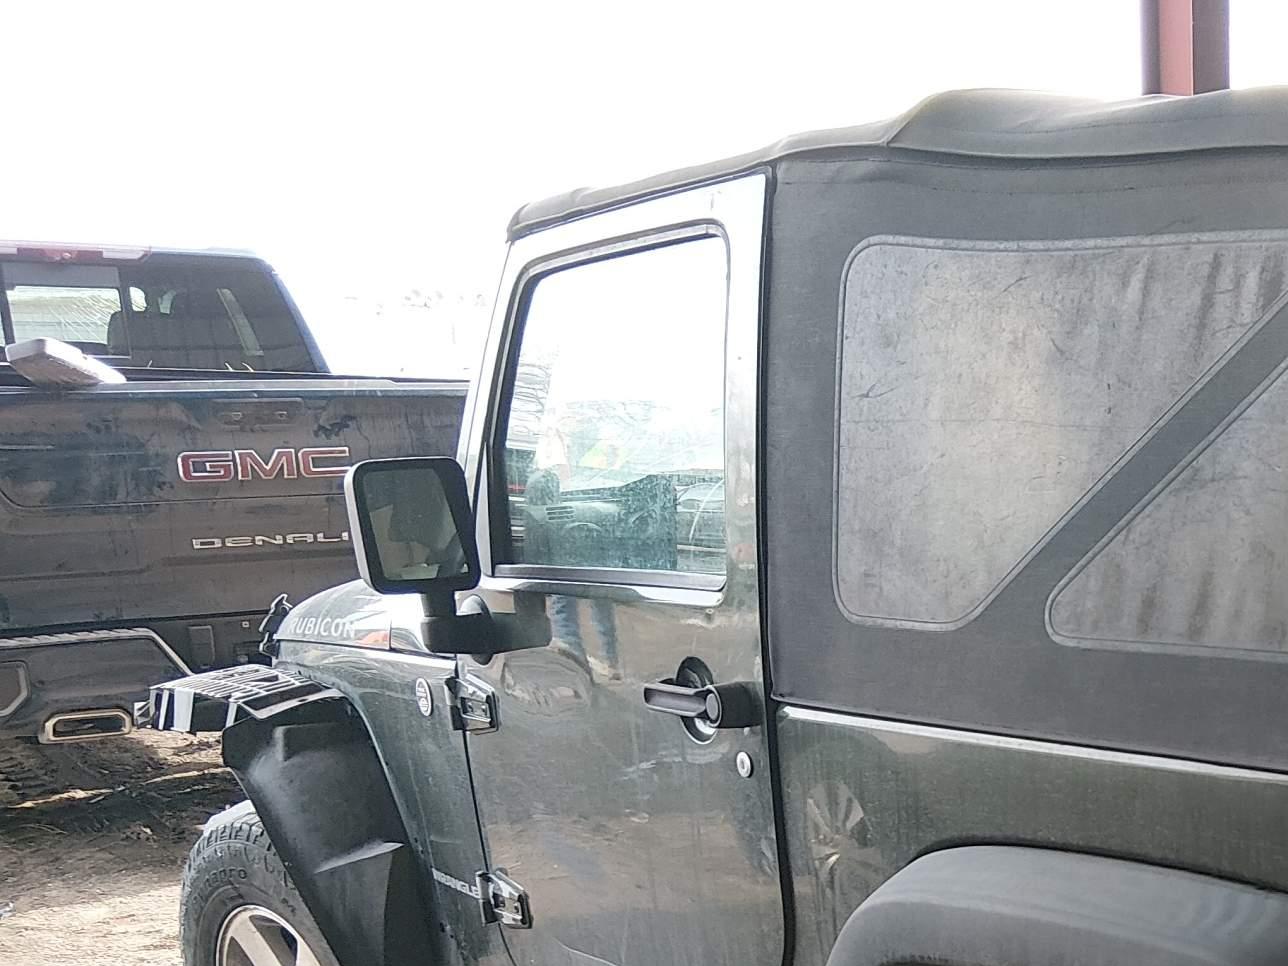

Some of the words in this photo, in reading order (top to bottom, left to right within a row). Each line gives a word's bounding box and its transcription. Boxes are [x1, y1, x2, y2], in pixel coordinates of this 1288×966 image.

[177, 446, 352, 482] GMC
[192, 531, 349, 550] DENALI
[288, 616, 356, 639] RUBICON
